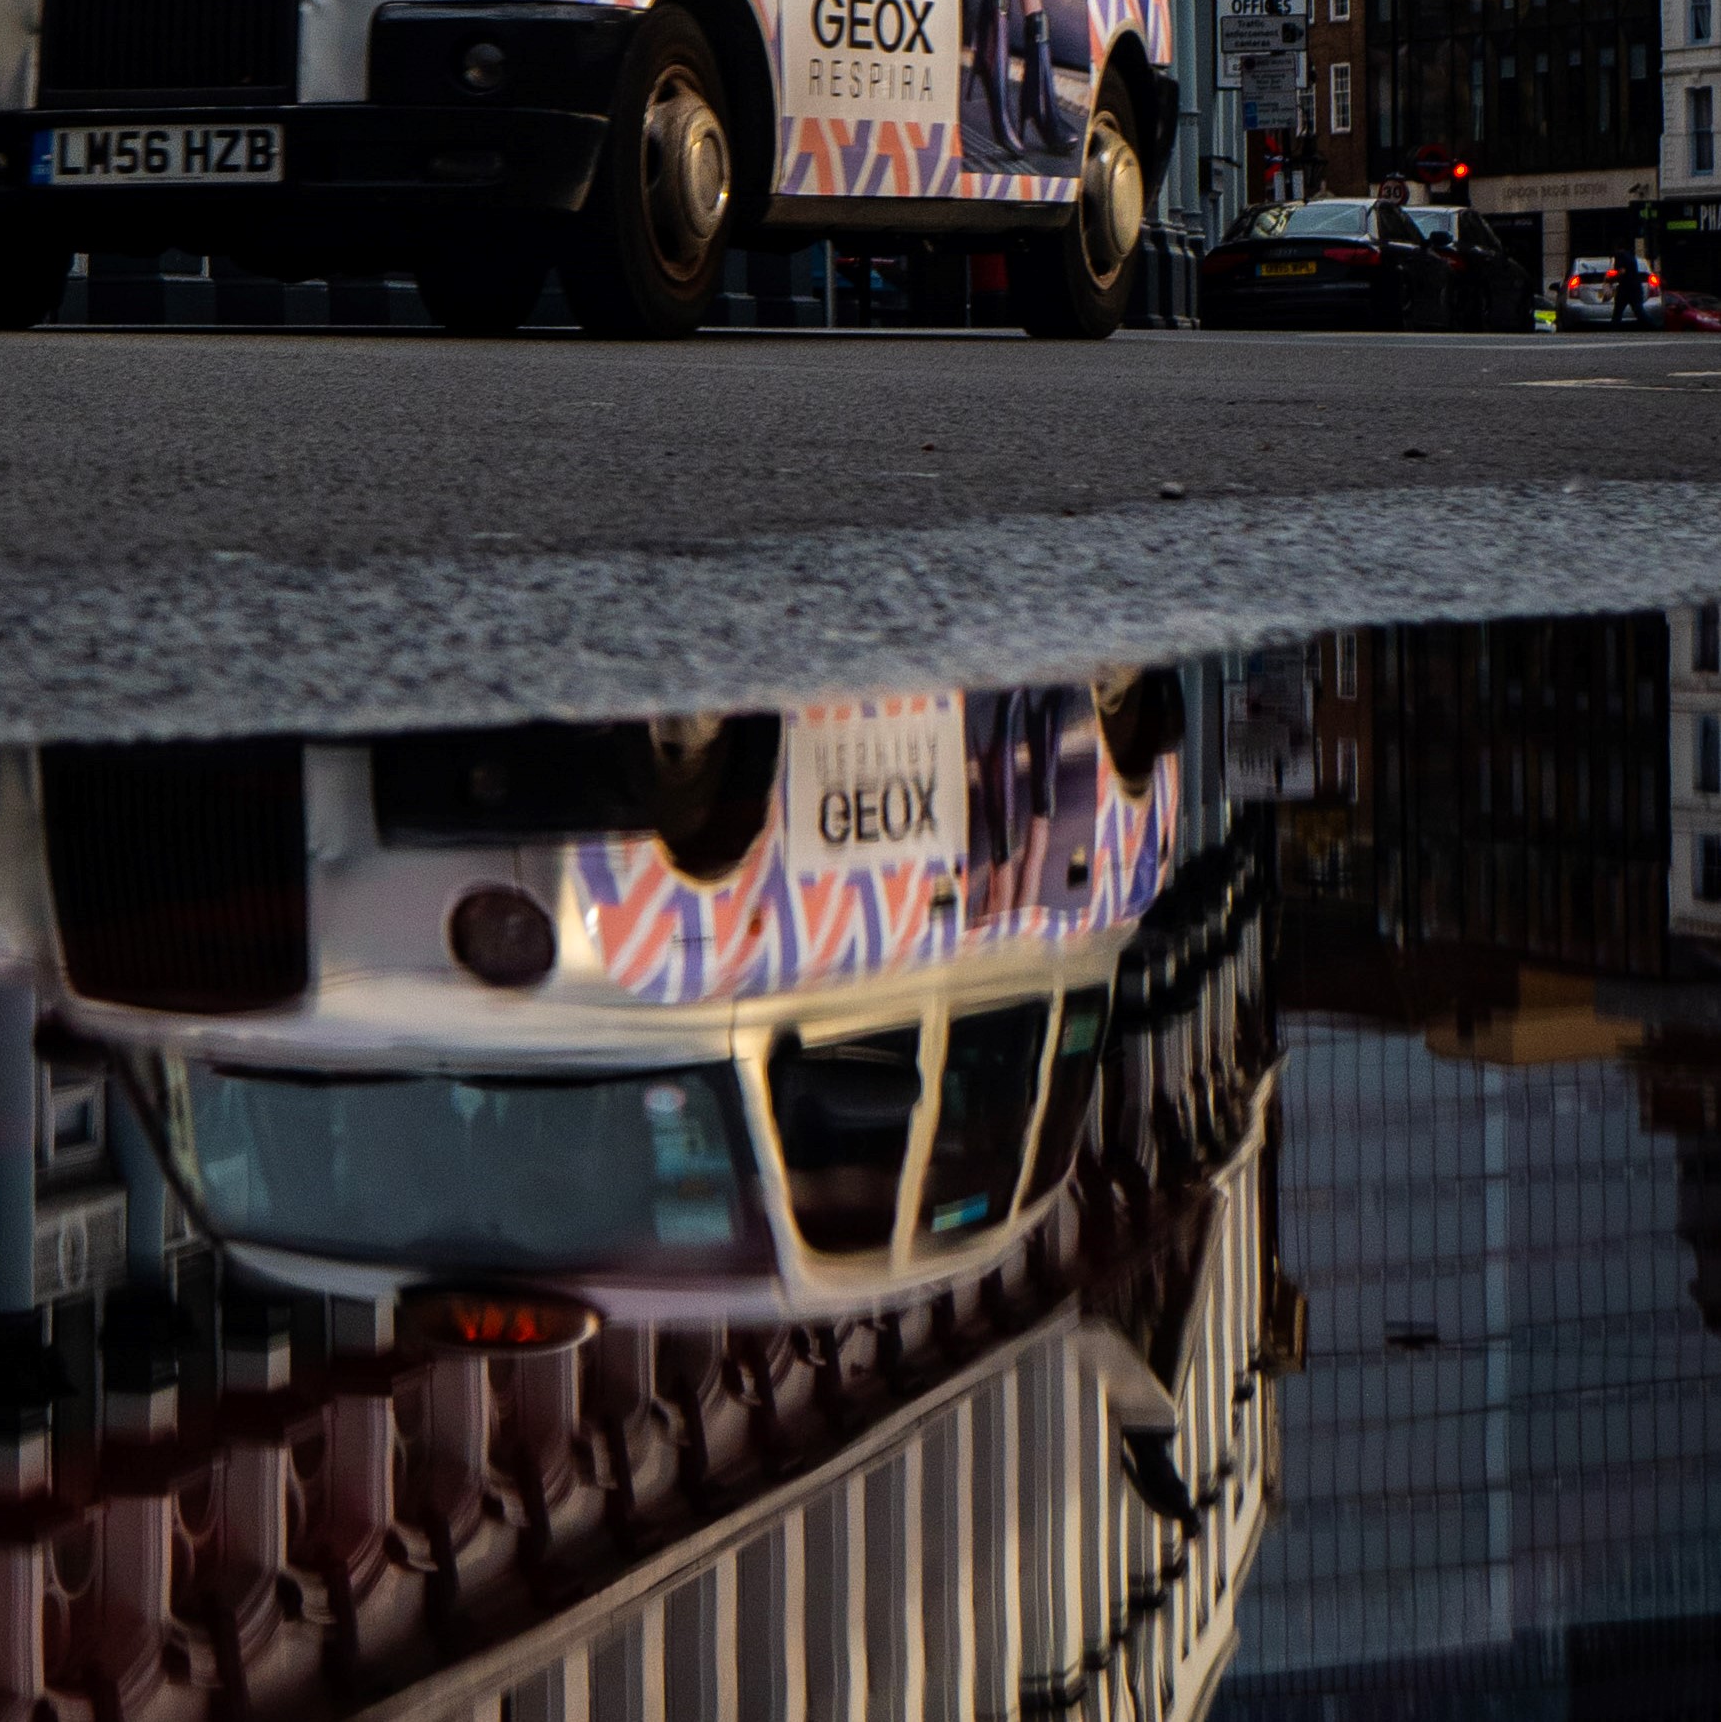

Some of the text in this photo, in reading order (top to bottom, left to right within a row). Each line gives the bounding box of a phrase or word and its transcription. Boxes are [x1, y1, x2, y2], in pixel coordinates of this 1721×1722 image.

[1238, 20, 1264, 28] Traffic
[809, 58, 934, 102] RESPIRA
[184, 129, 272, 173] HZB
